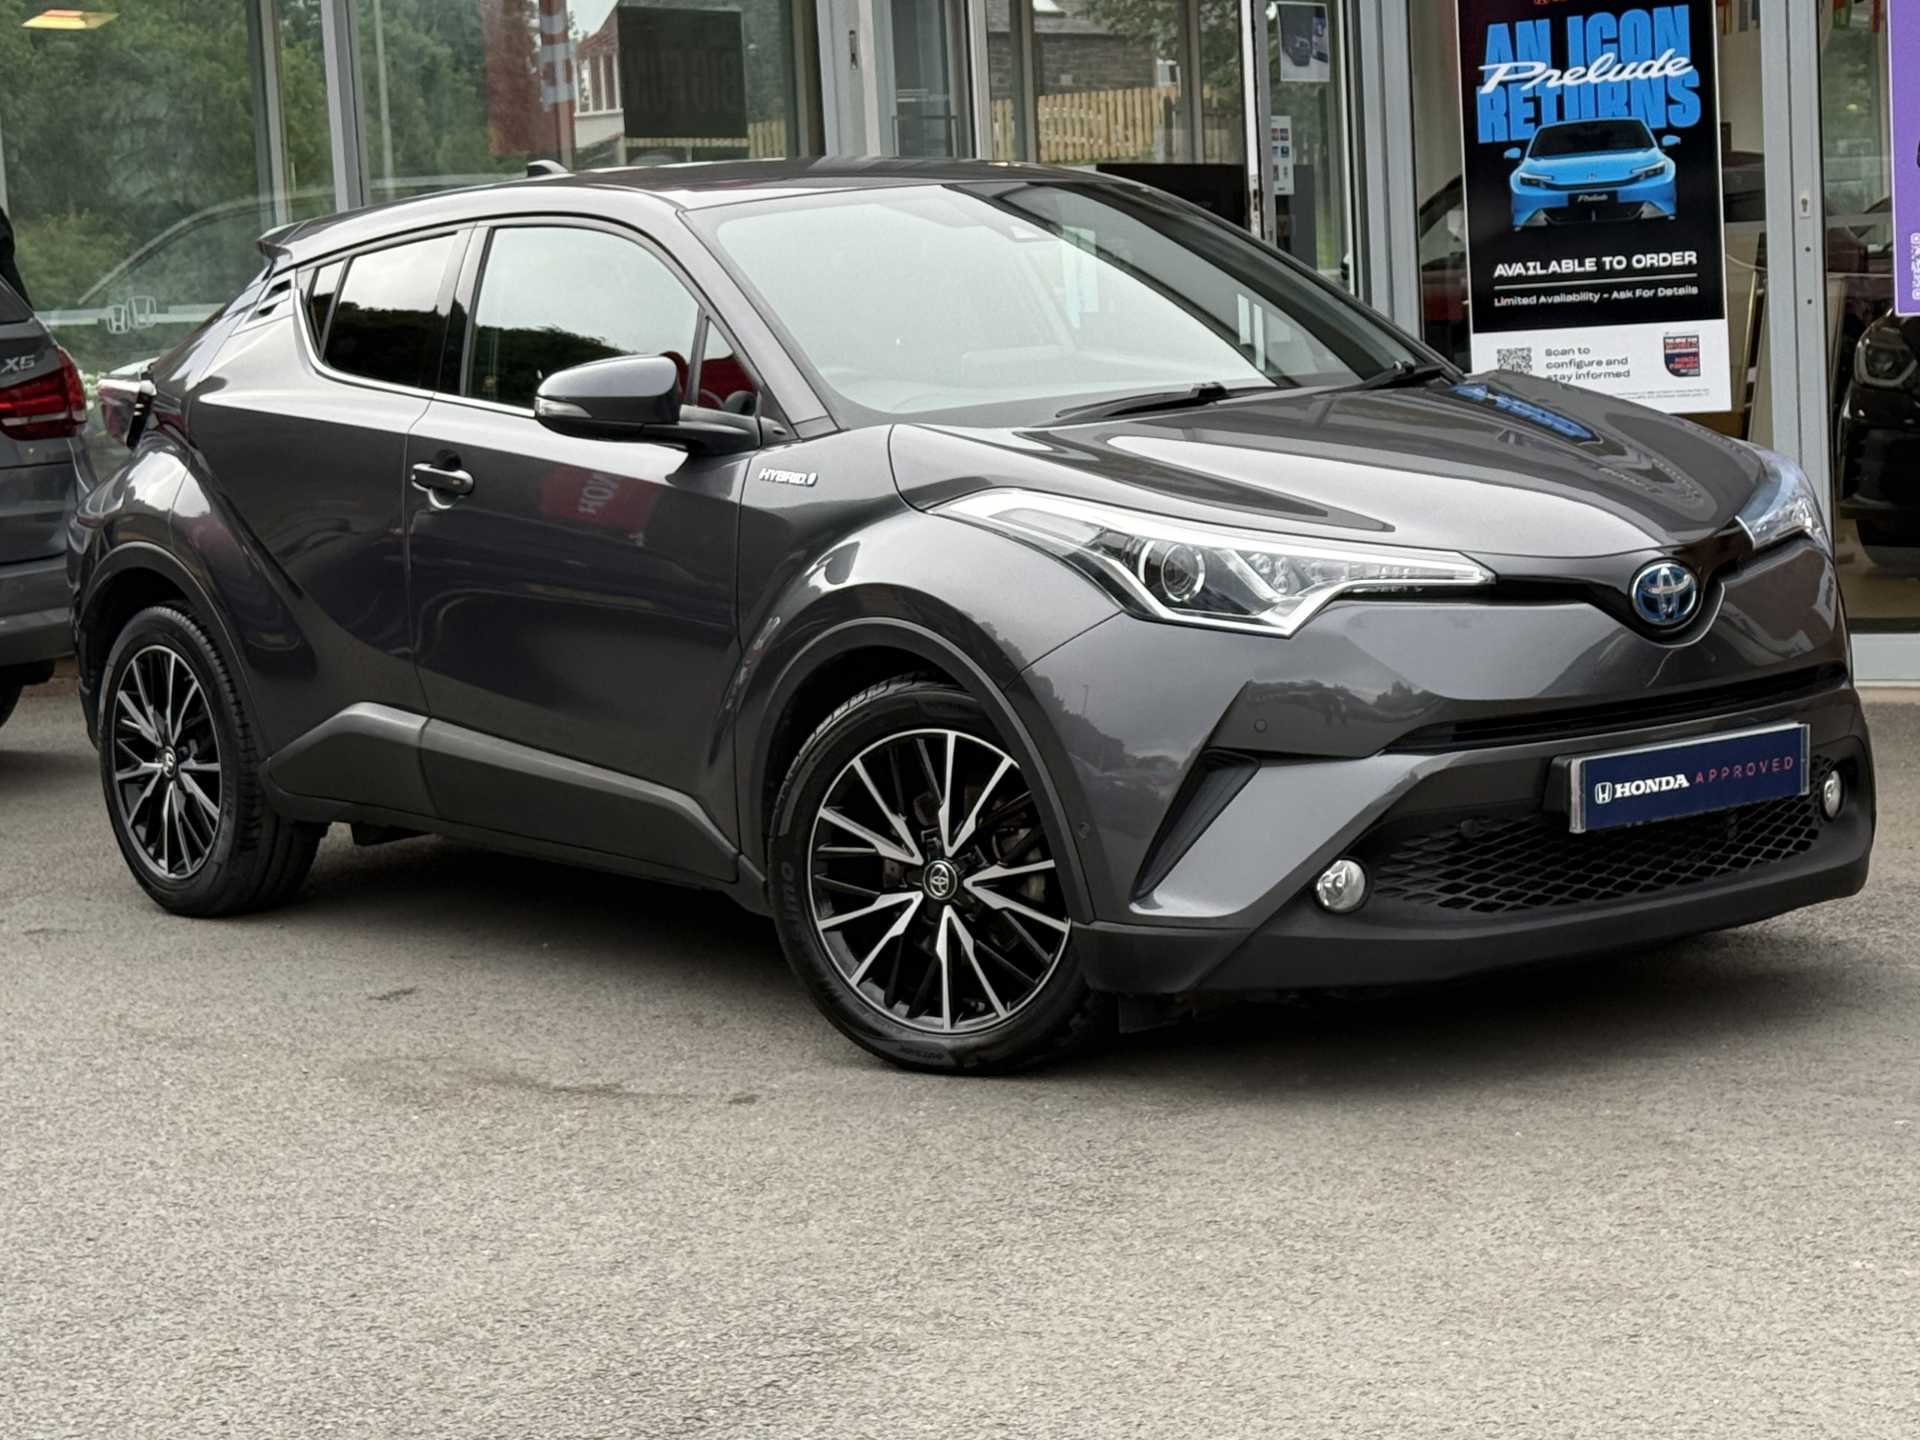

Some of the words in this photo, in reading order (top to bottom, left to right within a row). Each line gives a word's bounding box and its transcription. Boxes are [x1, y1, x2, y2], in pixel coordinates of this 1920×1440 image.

[1484, 19, 1551, 82] AN
[1567, 4, 1691, 74] ICON
[1478, 48, 1694, 94] Prelude
[1476, 70, 1701, 143] RETURNS
[1493, 257, 1597, 278] AVAILABLE
[1601, 255, 1627, 270] TO
[1632, 251, 1697, 269] ORDER
[1494, 294, 1537, 307] Limited
[1539, 291, 1600, 304] Availability
[1611, 289, 1634, 300] Ask
[1635, 288, 1656, 298] For
[1657, 285, 1698, 297] Details
[1545, 348, 1576, 357] Scan
[1577, 347, 1591, 355] to
[1545, 358, 1604, 370] configure
[1605, 356, 1628, 366] and
[1575, 370, 1631, 380] informed
[1614, 774, 1690, 799] HONDA
[1695, 756, 1793, 784] APPROVED
